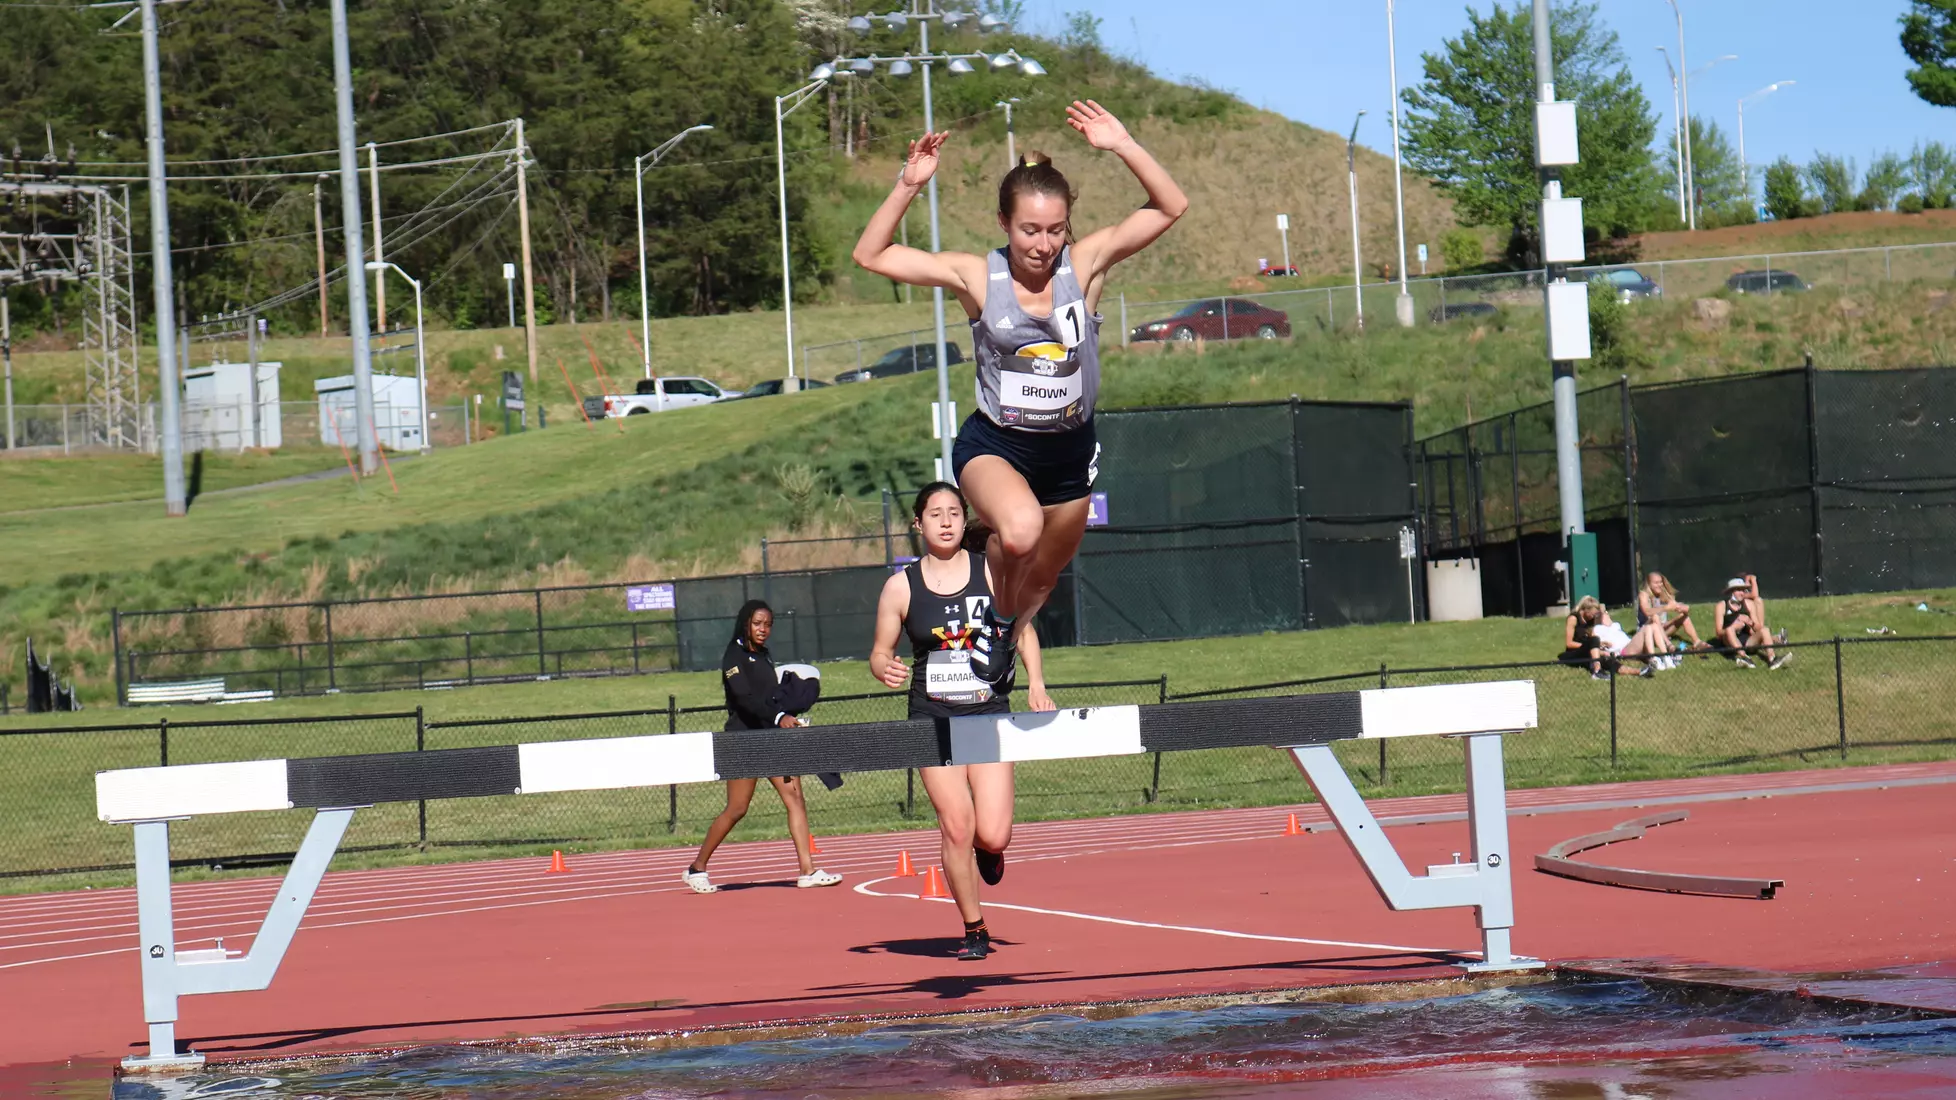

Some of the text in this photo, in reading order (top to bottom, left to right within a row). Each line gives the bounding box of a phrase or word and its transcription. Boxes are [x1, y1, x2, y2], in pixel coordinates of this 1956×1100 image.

[1066, 305, 1080, 342] 1
[1022, 385, 1068, 399] BROWN
[972, 598, 986, 625] 4
[930, 672, 976, 682] BELAMAR
[1488, 855, 1499, 864] 30
